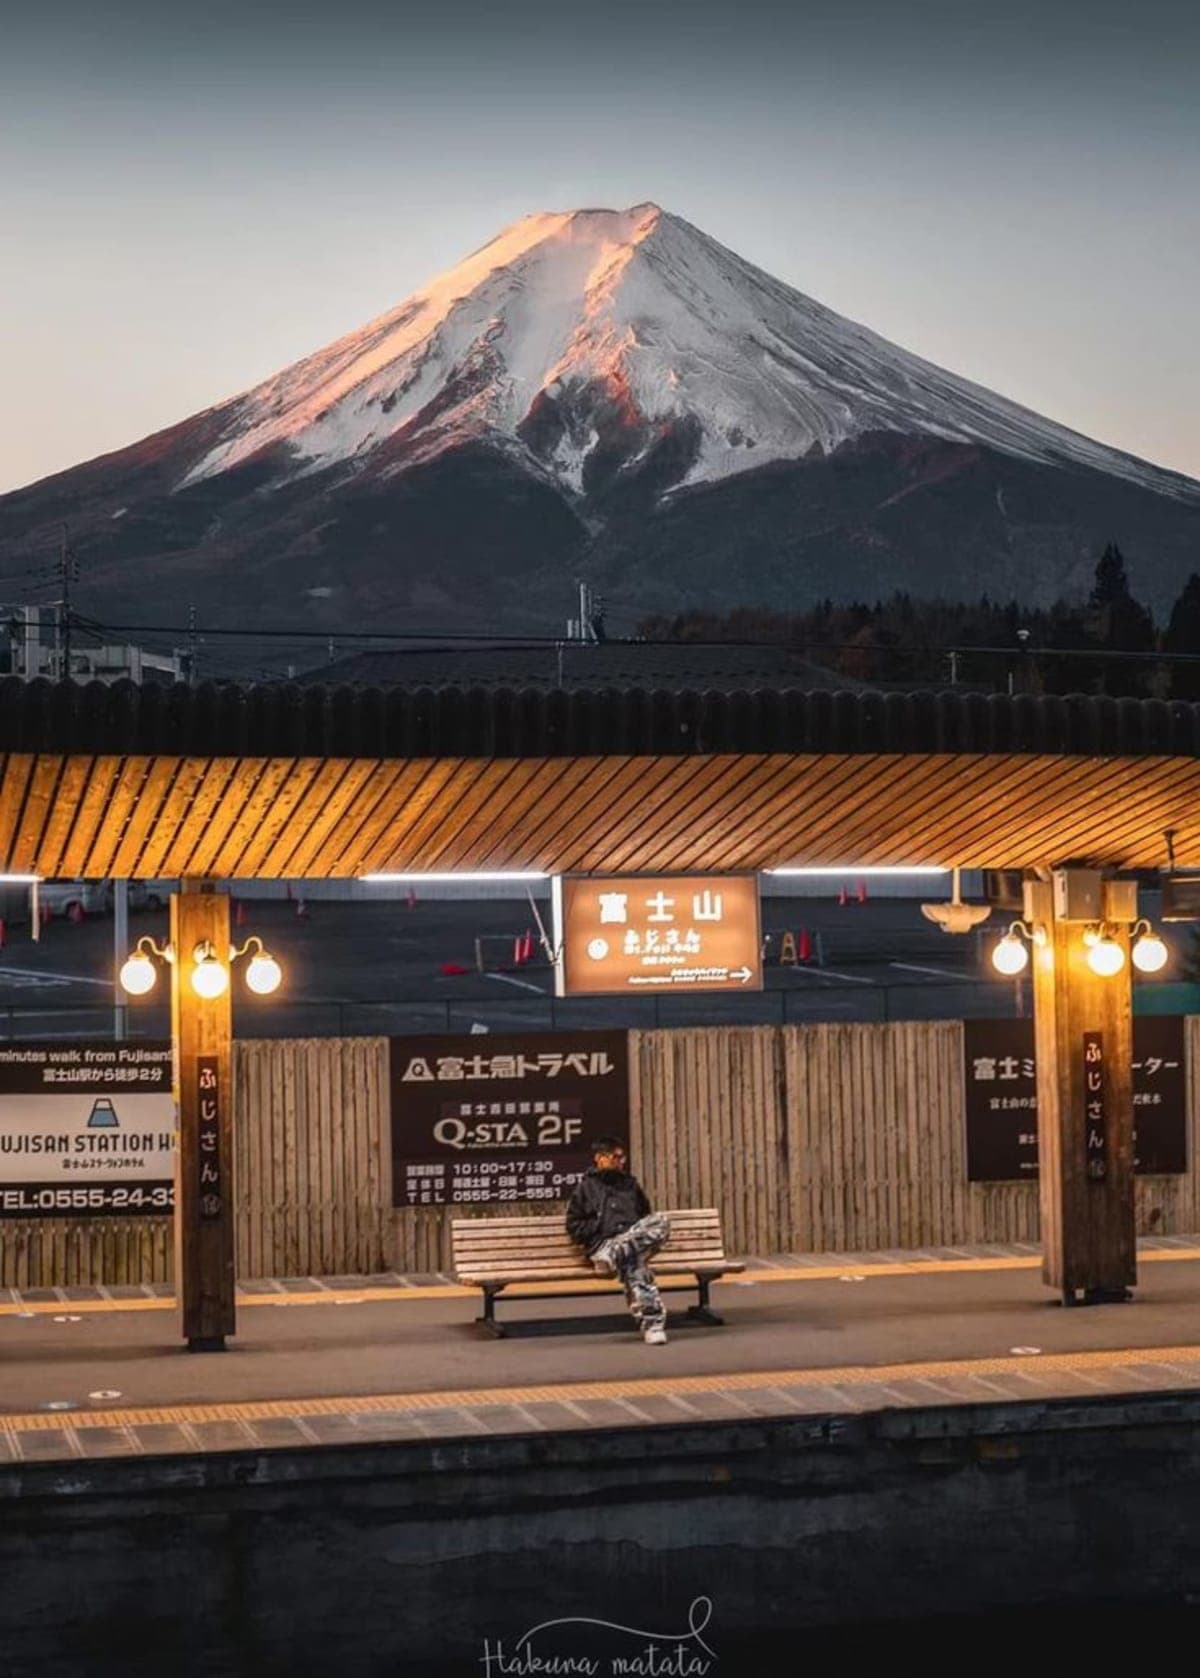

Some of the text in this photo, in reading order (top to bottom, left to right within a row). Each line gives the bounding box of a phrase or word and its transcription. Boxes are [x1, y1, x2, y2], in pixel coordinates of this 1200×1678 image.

[599, 890, 722, 923] 富士山
[50, 1049, 81, 1062] walk
[85, 1049, 116, 1062] from
[436, 1052, 615, 1080] 富士急トラベル
[1086, 1043, 1103, 1148] ふじさん
[200, 1068, 218, 1183] ふじさん
[538, 1115, 582, 1144] 2F
[75, 1133, 154, 1151] STATION
[159, 1133, 175, 1150] H
